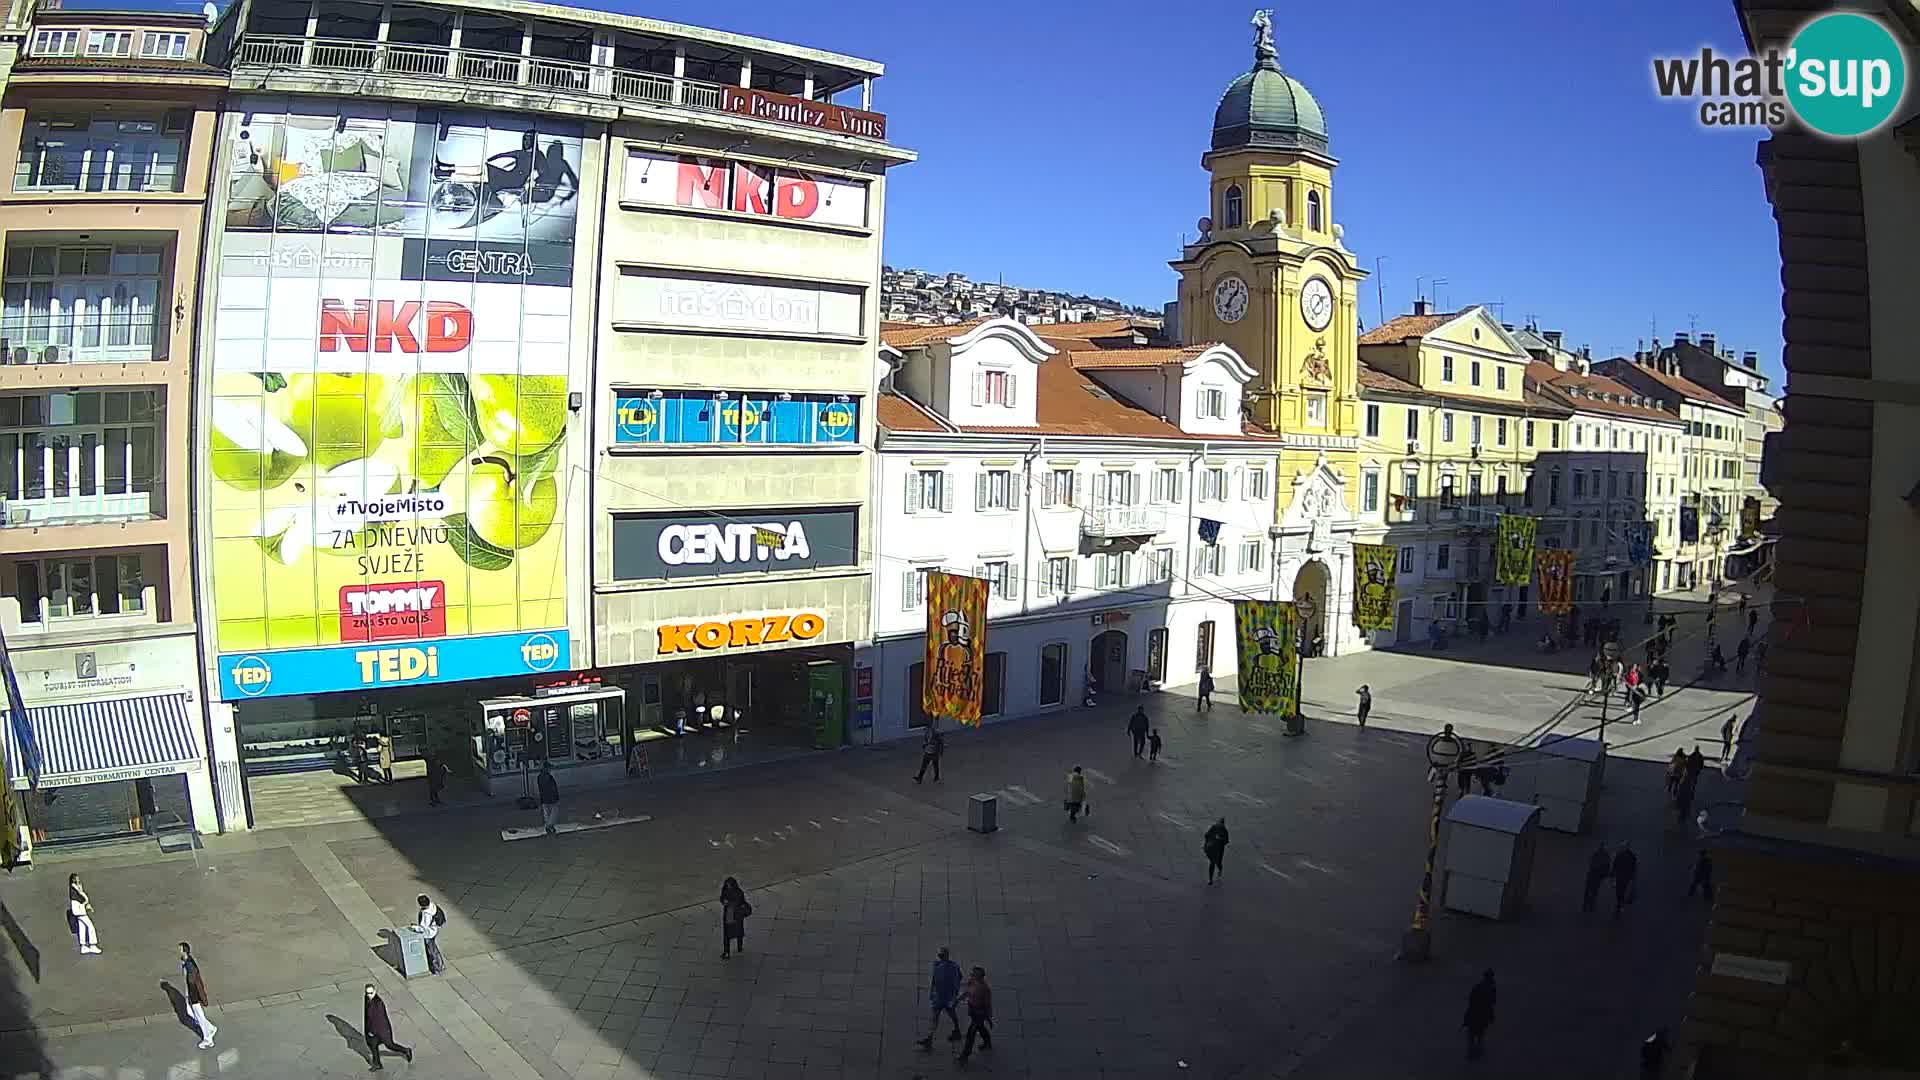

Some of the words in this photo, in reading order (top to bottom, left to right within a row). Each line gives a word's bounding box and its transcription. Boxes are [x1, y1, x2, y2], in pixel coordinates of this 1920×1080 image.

[722, 88, 745, 111] Le
[676, 155, 819, 219] NKD
[446, 249, 534, 276] CENTRA
[319, 298, 475, 354] NKD
[337, 498, 445, 517] #TvojeMisto
[332, 530, 356, 549] ZA
[366, 526, 449, 548] DNEVNO
[358, 548, 425, 575] SVJEŽE
[346, 586, 438, 616] TOMMY
[378, 615, 398, 626] ŠTO
[657, 613, 825, 655] KORZO
[356, 646, 438, 684] TEDi
[521, 643, 559, 663] TEDi
[231, 666, 272, 687] TEDi
[85, 770, 141, 782] INFORMATIVNI
[144, 766, 177, 776] CENTAR
